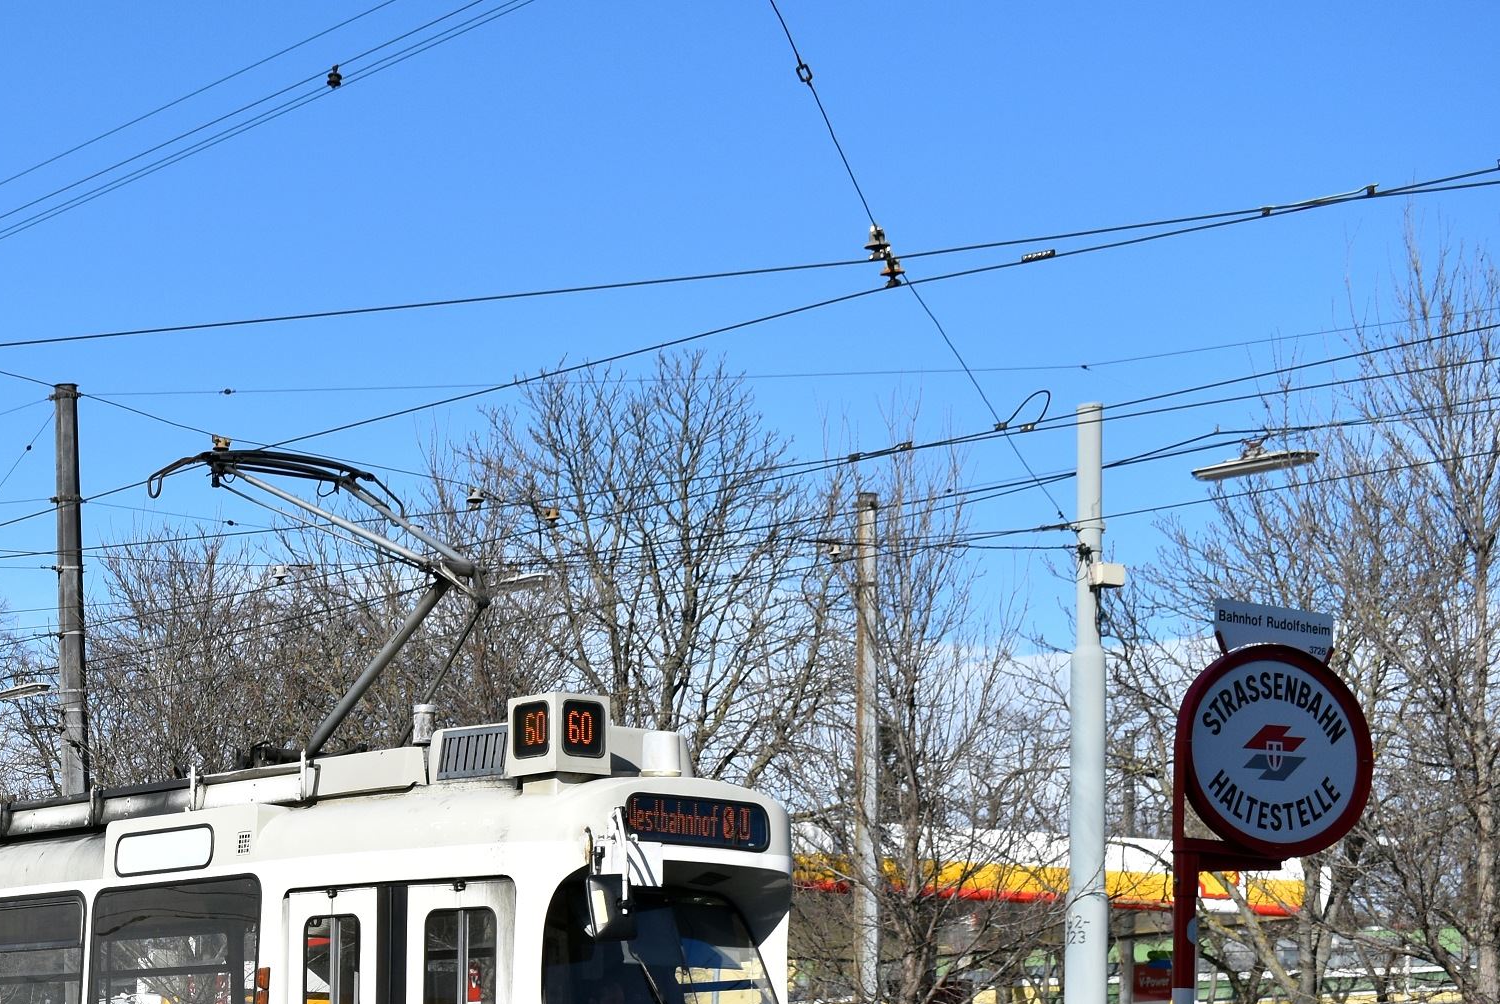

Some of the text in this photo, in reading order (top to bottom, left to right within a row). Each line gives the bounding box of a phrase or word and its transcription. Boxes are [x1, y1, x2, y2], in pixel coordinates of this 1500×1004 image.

[1218, 609, 1331, 636] Bahnhof Rudolfsheim
[1202, 672, 1347, 745] STRASSENBAHN
[525, 711, 546, 745] 60
[568, 710, 593, 745] 60
[1208, 769, 1341, 832] HALTESTELLE
